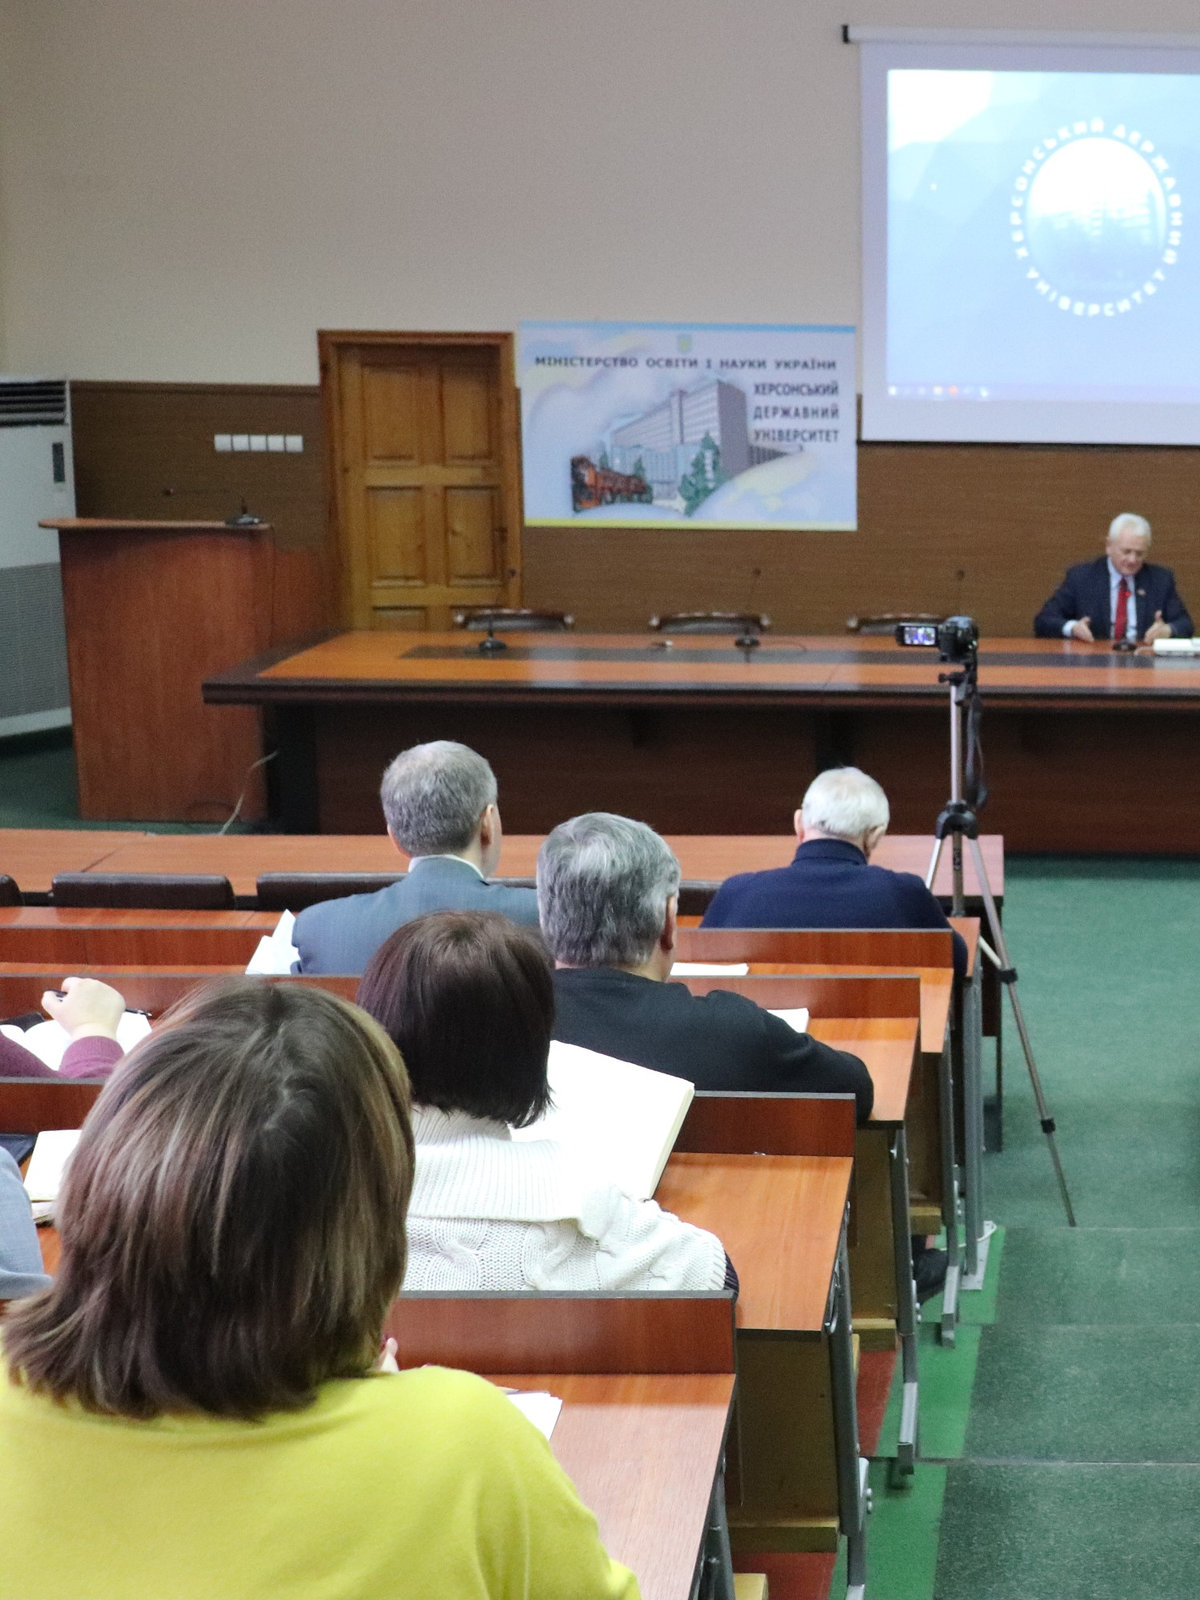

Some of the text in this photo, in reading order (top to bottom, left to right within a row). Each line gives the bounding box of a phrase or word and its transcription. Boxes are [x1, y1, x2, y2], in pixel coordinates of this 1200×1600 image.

[535, 355, 837, 370] МІНІСТЕРСТВО ОСВІТИ І НАУКИ УКРАЇНИ
[754, 380, 839, 396] ХЕРСОНСЬКИЙ
[753, 403, 840, 420] ДЕРЖАВНИЙ
[754, 429, 839, 442] УНІВЕРСИТЕТ
